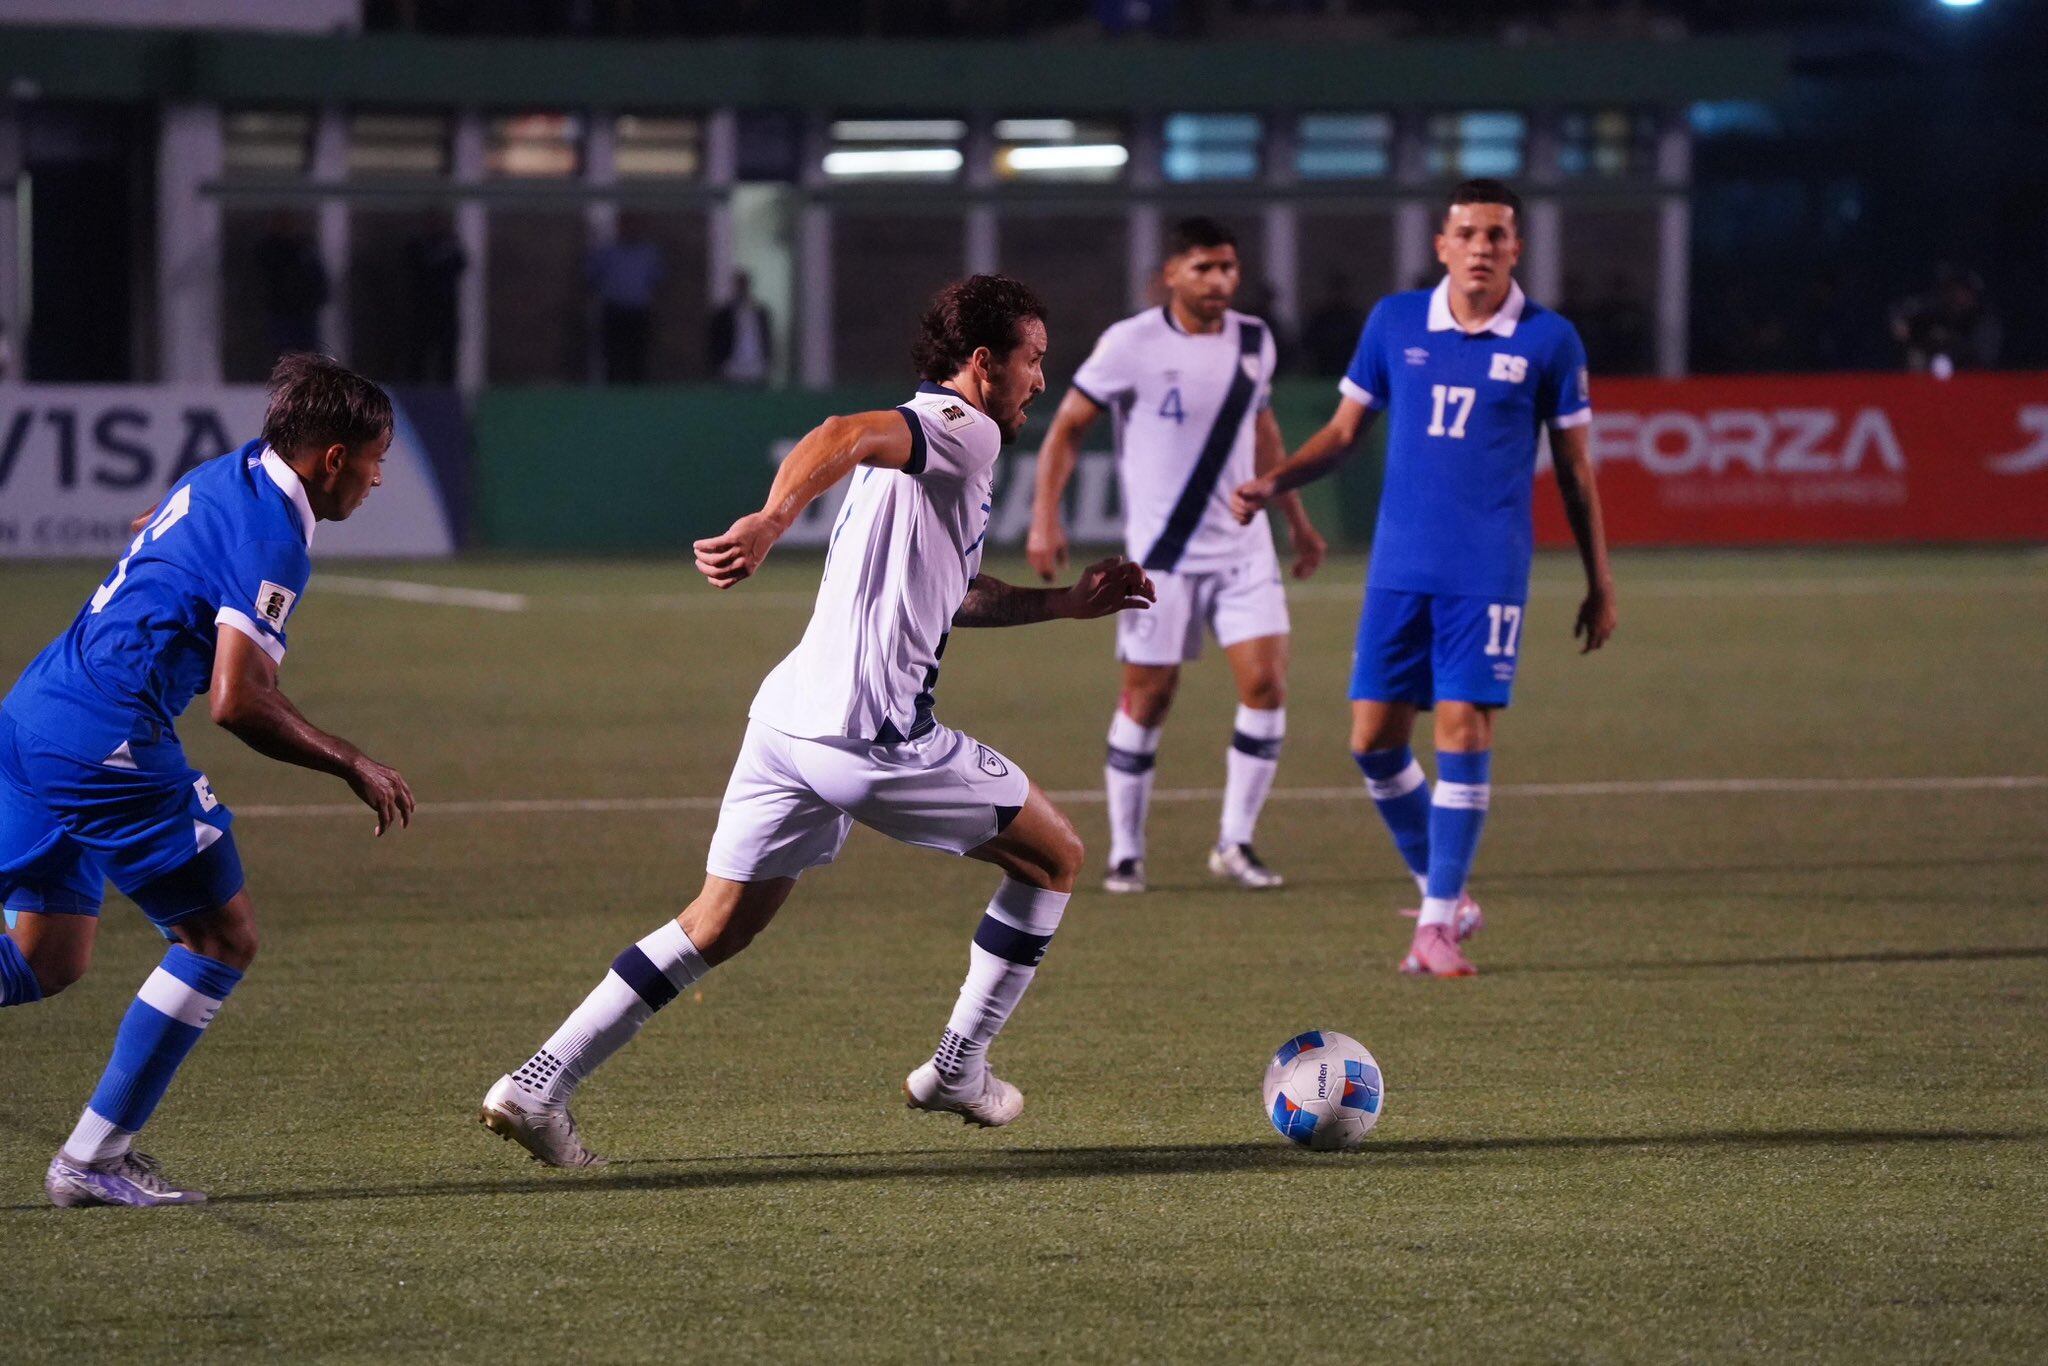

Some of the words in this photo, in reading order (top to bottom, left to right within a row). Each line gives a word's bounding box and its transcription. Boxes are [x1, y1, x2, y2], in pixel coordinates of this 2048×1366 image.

[1488, 352, 1528, 384] ES
[1159, 387, 1186, 425] 4
[1427, 384, 1476, 438] 17
[1590, 407, 1905, 476] FORZA
[1484, 603, 1521, 656] 17
[1317, 1063, 1328, 1098] molten
